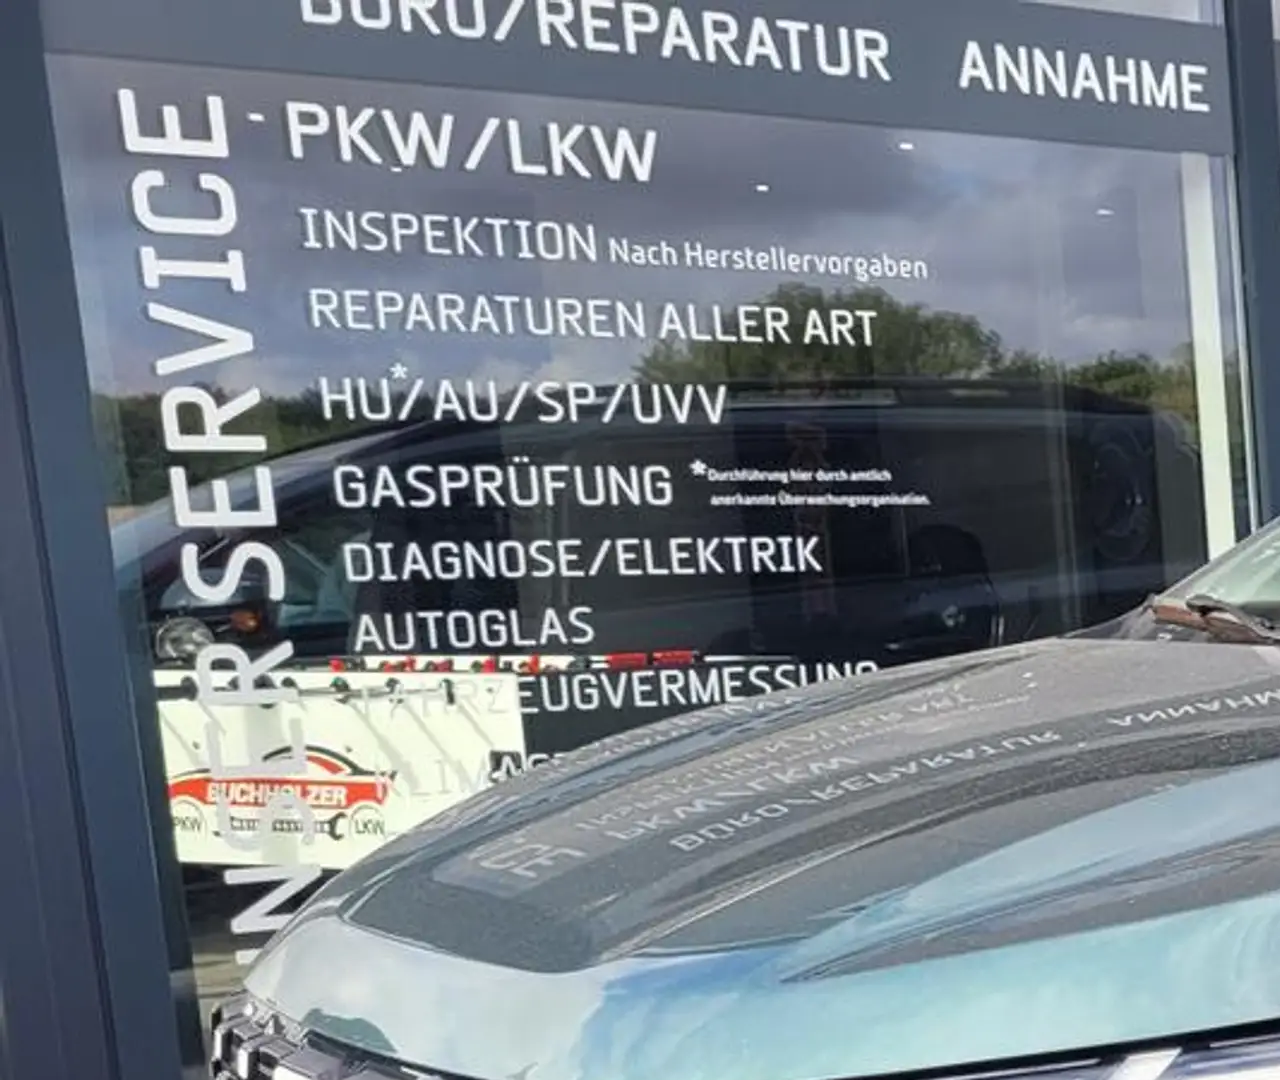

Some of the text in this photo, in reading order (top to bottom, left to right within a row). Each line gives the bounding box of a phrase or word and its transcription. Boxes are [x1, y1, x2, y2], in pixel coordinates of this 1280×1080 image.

[958, 40, 1211, 113] ANNAHME
[286, 101, 658, 183] PKW/LKW
[299, 207, 928, 283] INSPEKTION Nach Herstellervorgaben
[117, 87, 287, 602] SERVICE
[308, 287, 878, 347] REPARATUREN ALLER ART
[333, 456, 673, 509] GASPRÜFUNG
[342, 535, 824, 583] DIAGNOSE/ELEKTRIK
[354, 605, 596, 652] AUTOGLAS
